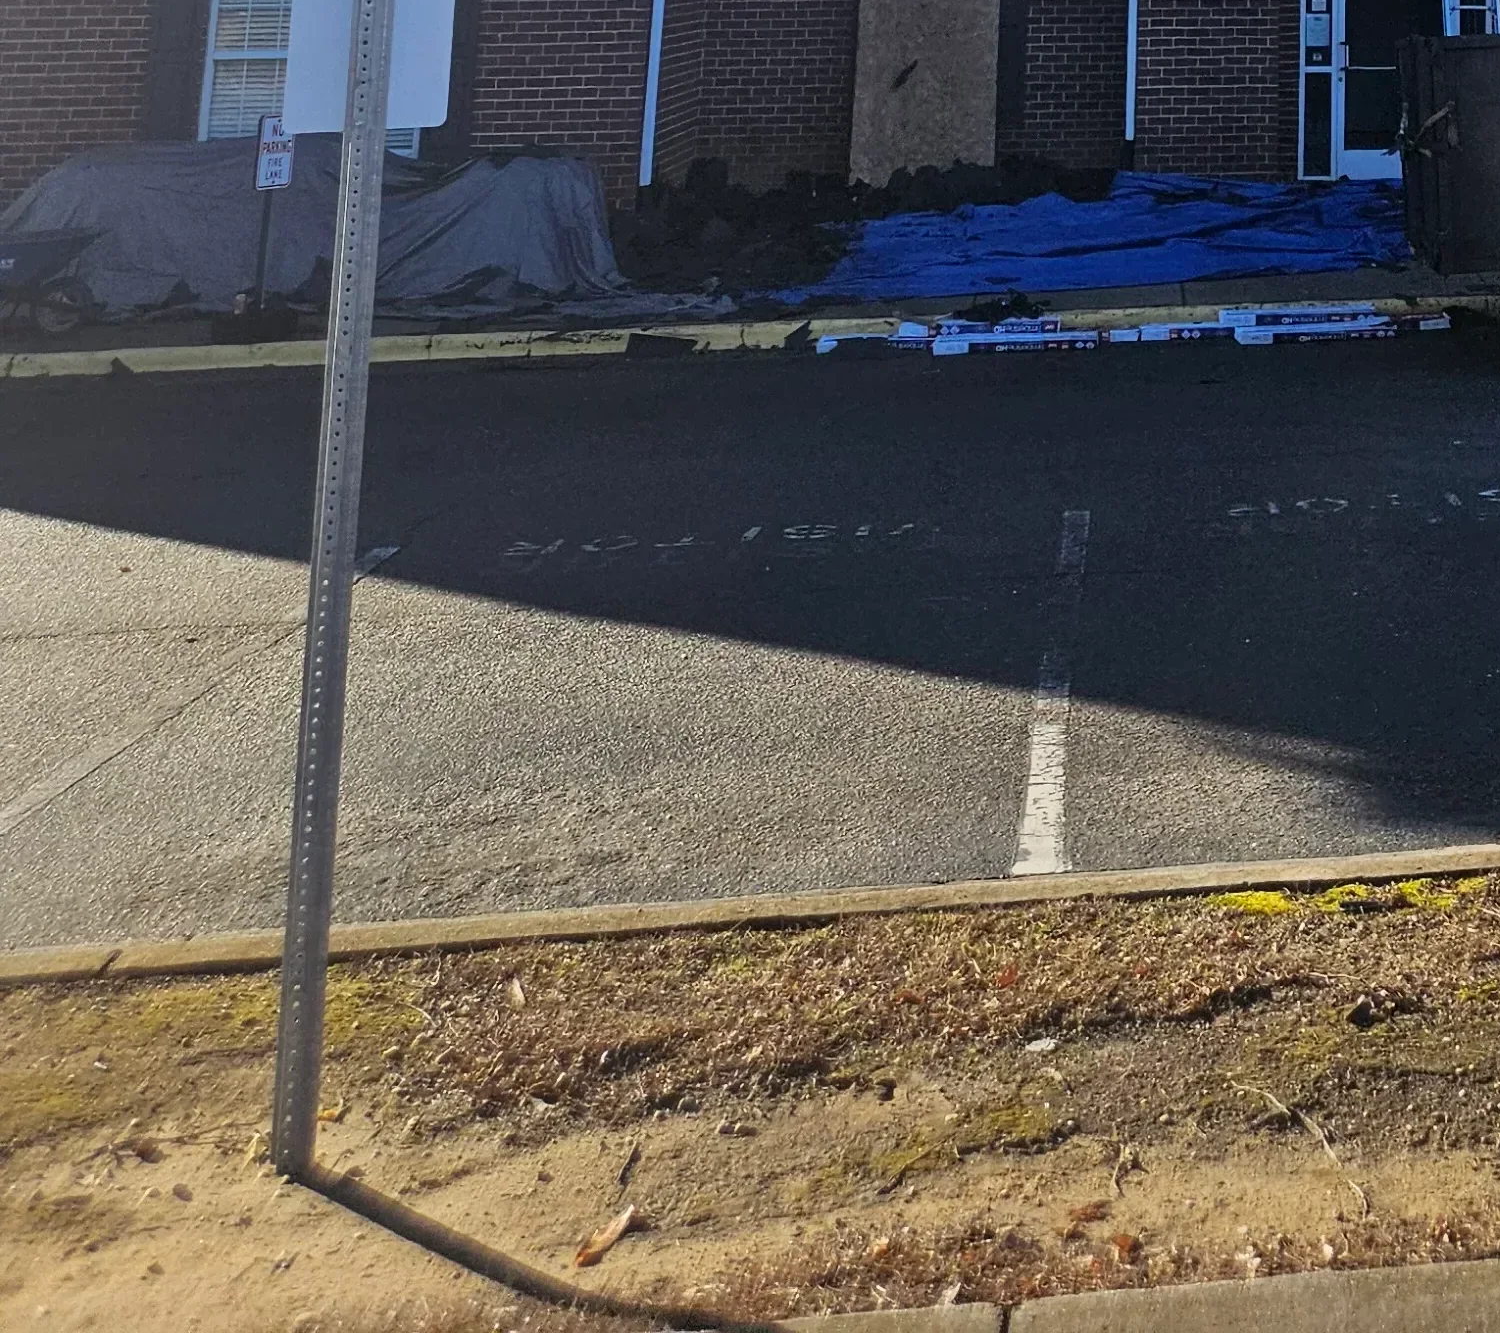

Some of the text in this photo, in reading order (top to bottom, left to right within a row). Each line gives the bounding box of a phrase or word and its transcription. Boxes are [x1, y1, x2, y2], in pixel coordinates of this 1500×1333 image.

[262, 139, 292, 153] PARKING
[267, 157, 284, 168] FIRE
[264, 170, 283, 181] LANE
